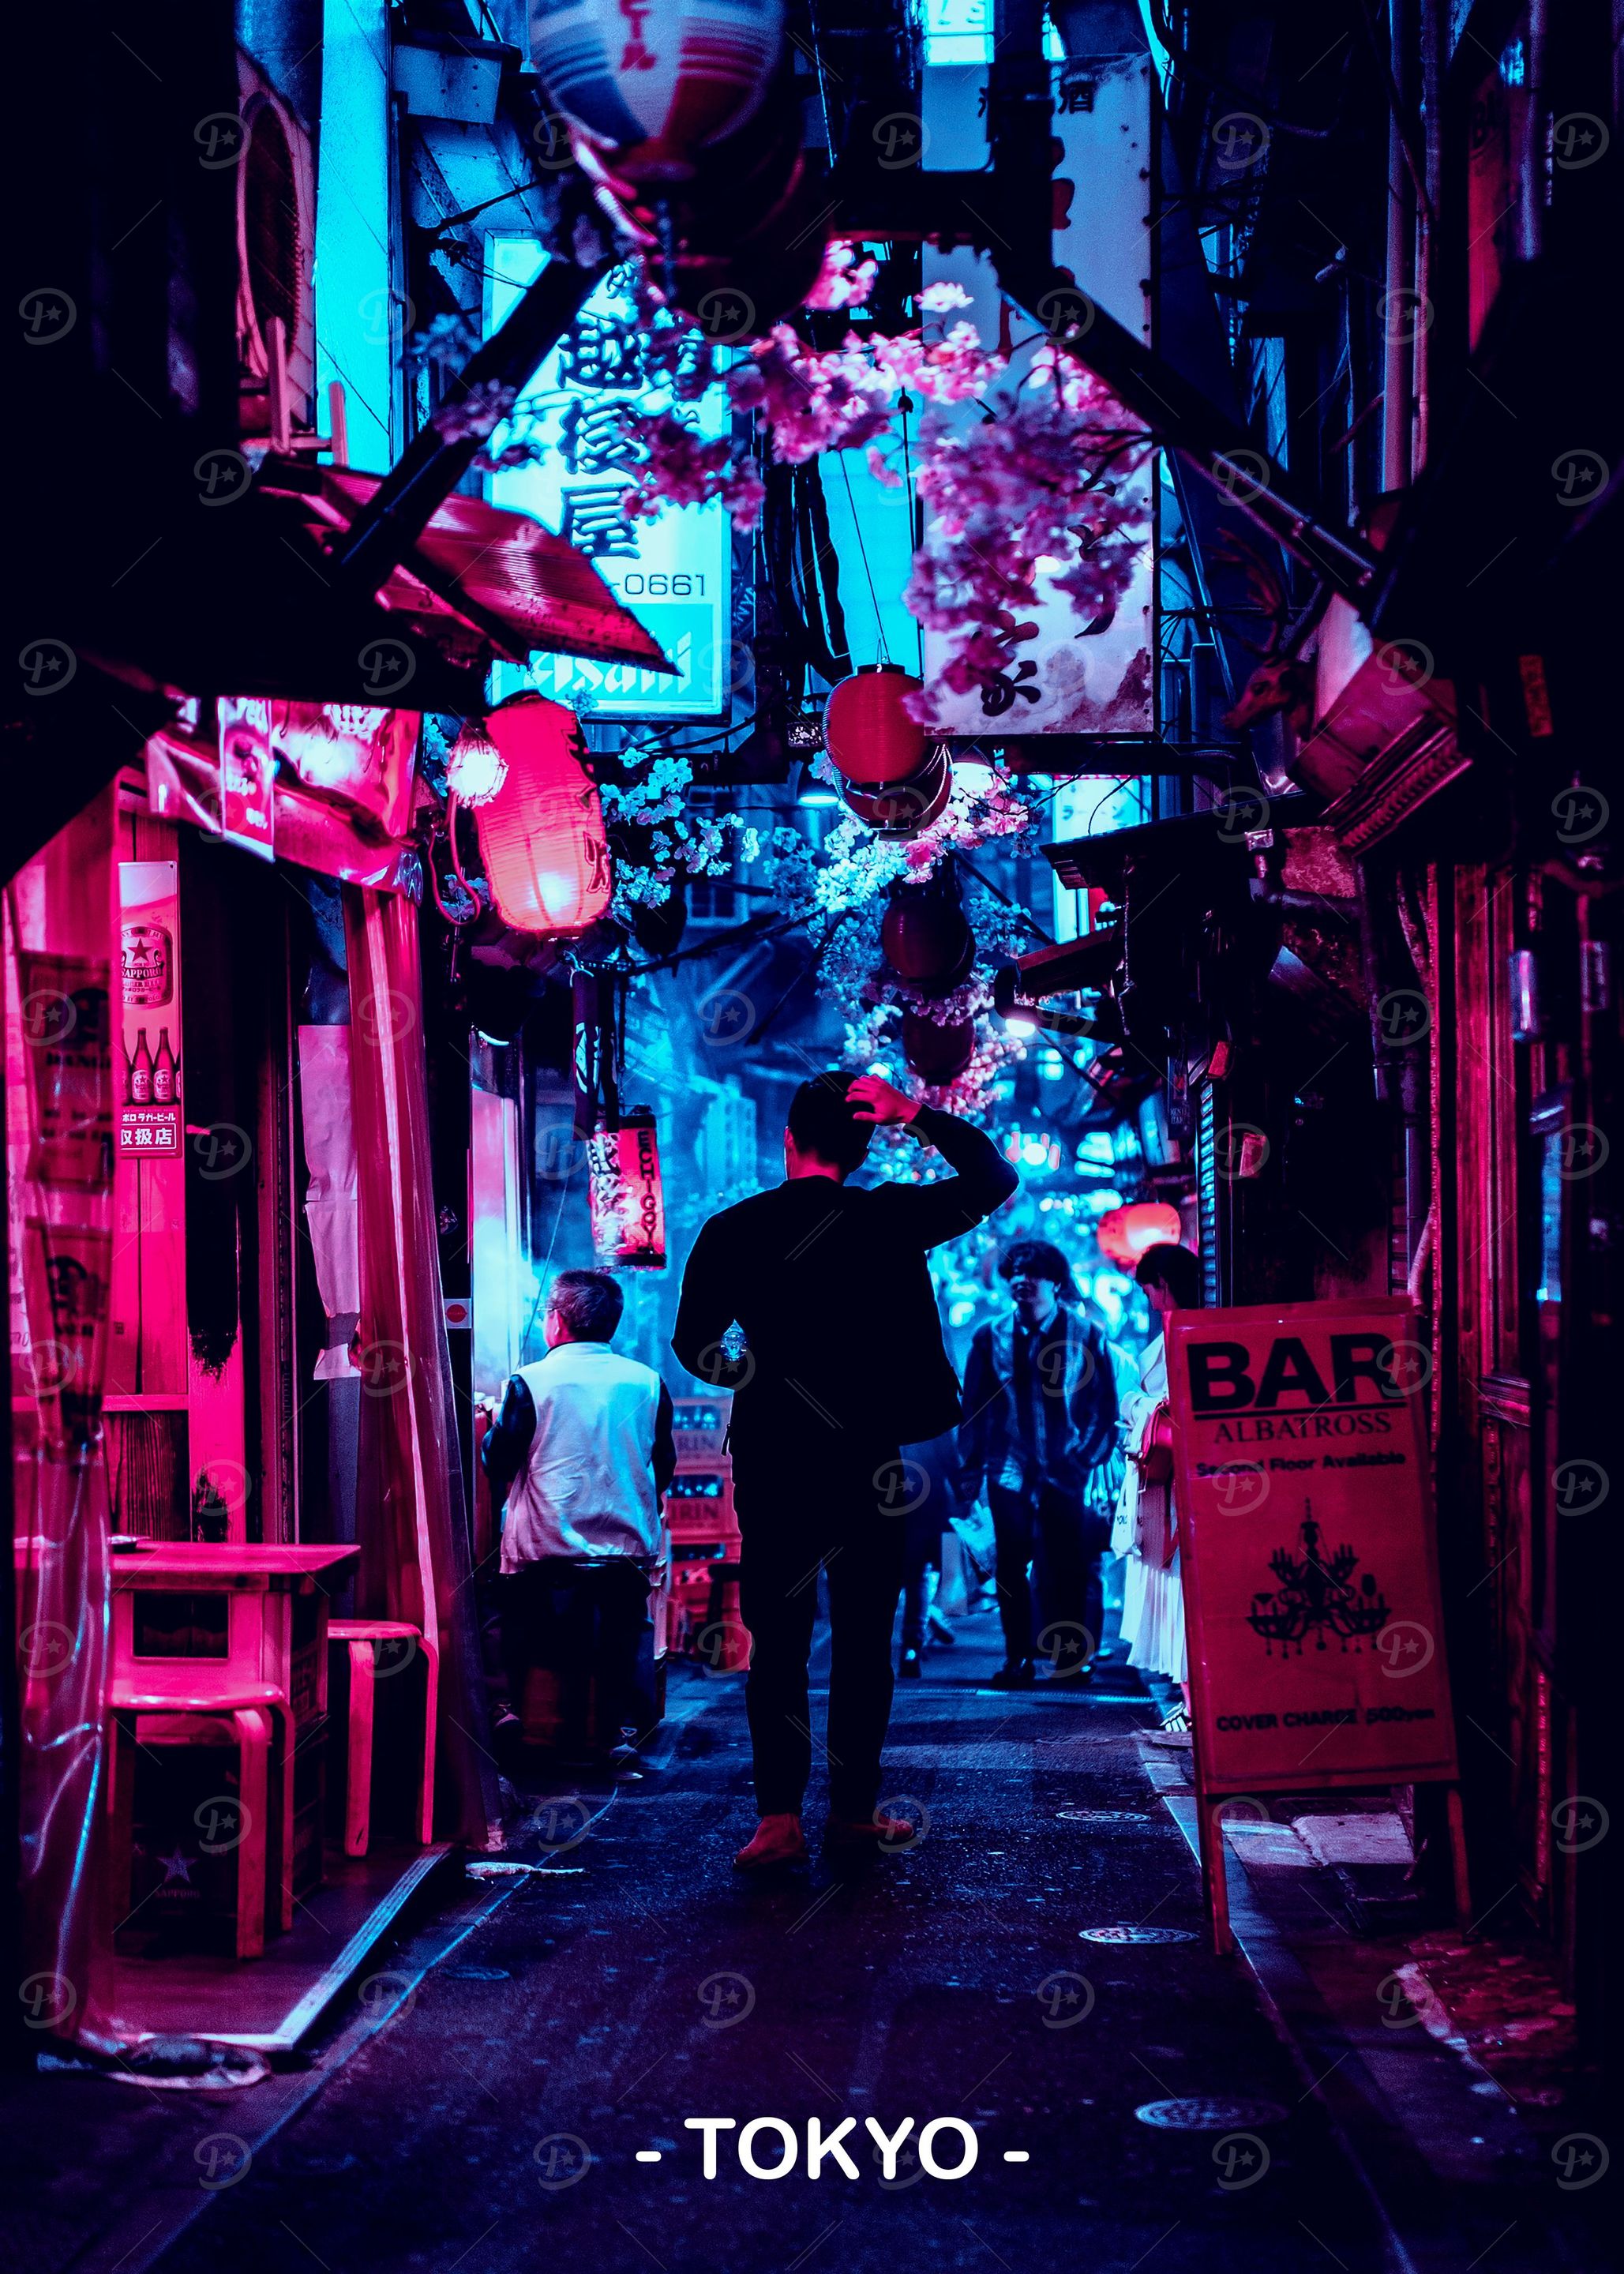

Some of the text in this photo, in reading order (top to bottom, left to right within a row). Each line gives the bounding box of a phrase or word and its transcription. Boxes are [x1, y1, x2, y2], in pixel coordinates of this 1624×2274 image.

[121, 967, 161, 979] SAPPORO
[637, 1130, 656, 1254] ECHIGOY
[1187, 1333, 1406, 1412] BAR
[1214, 1412, 1392, 1443] ALBATROSS
[1270, 1457, 1315, 1472] Floor
[1322, 1451, 1406, 1468] Available
[1217, 1713, 1278, 1732] COVER
